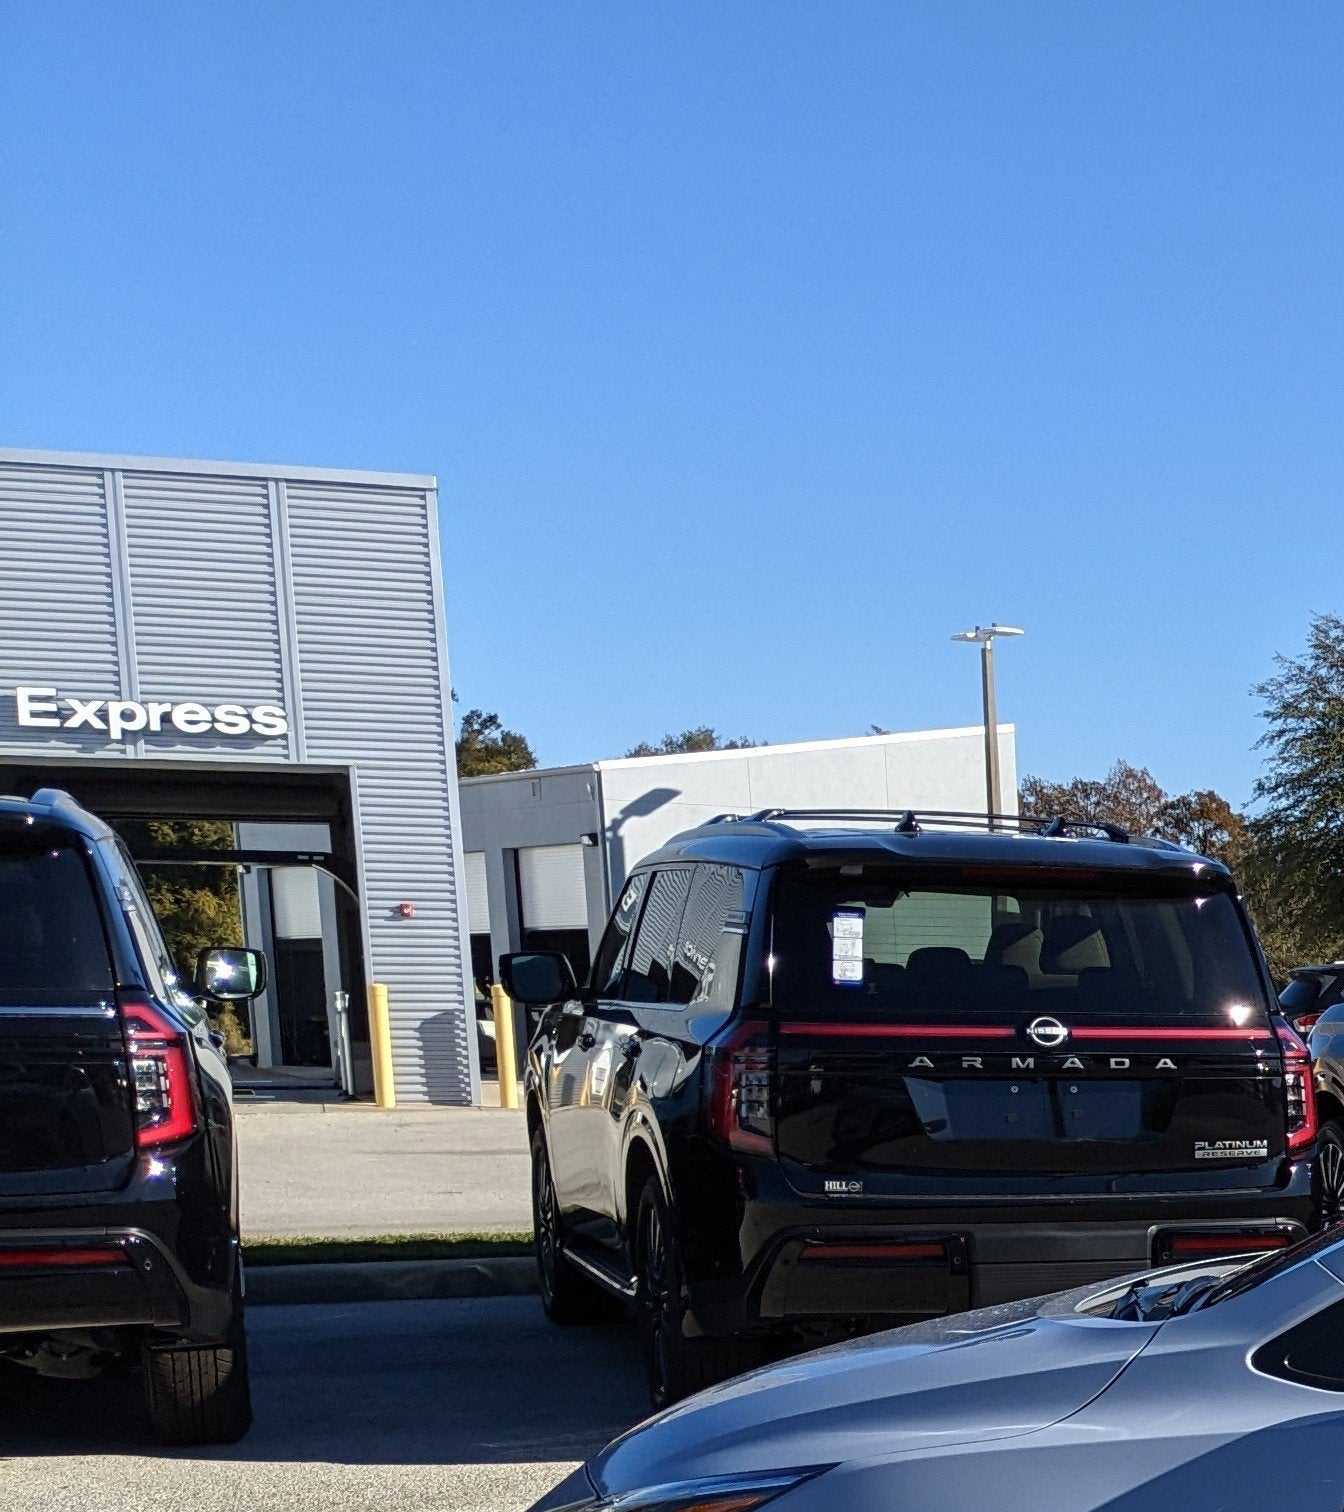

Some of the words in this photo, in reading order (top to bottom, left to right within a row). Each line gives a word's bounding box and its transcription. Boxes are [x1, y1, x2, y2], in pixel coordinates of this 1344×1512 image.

[16, 686, 288, 740] Express
[908, 1056, 1178, 1070] ARMADA
[1195, 1140, 1267, 1150] PLATINUM
[824, 1180, 848, 1191] HILL
